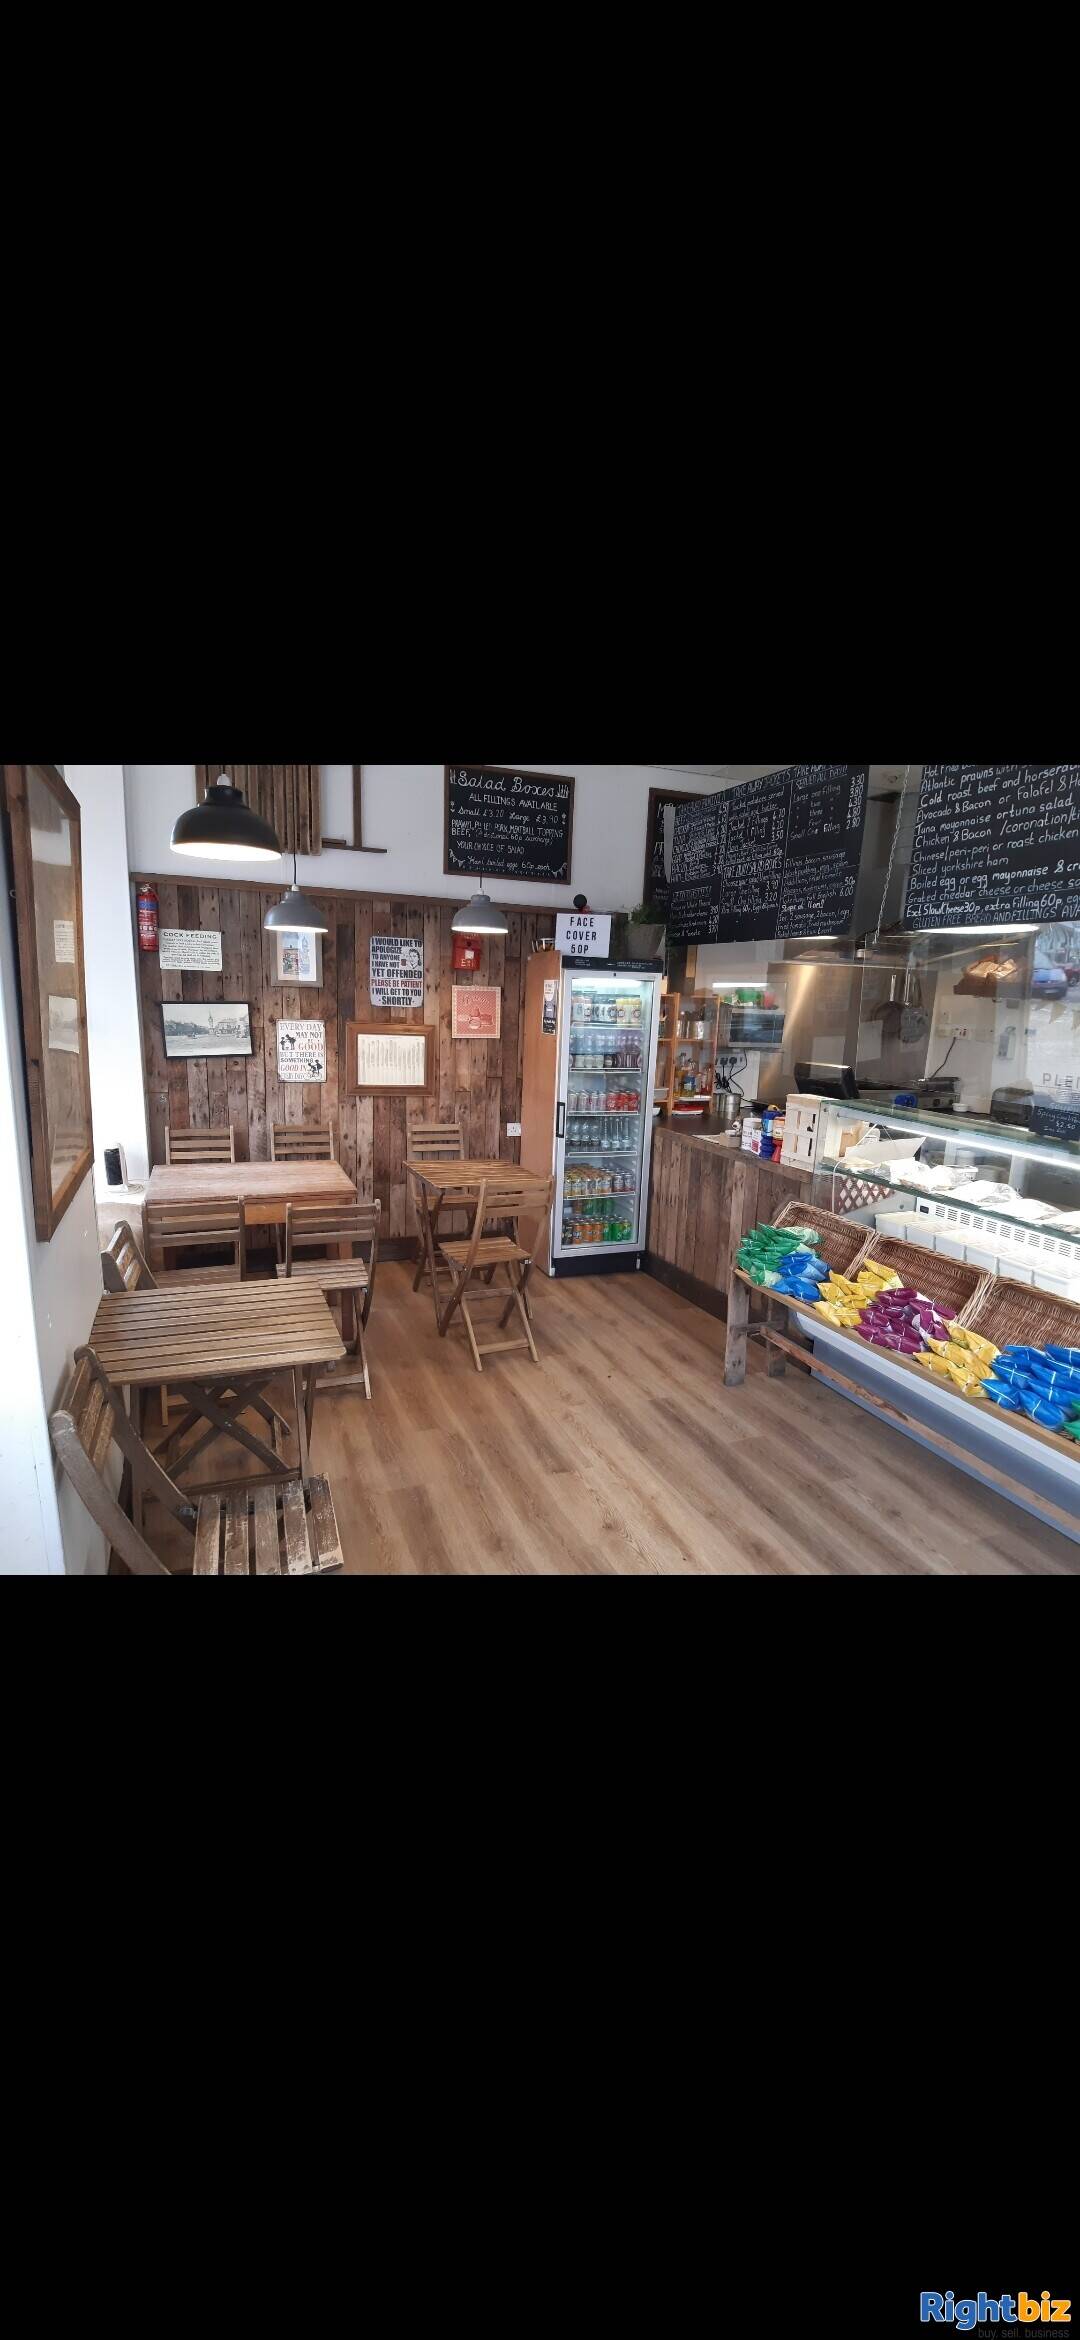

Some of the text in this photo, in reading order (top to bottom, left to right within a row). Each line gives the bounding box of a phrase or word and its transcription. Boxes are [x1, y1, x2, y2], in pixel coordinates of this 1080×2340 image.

[458, 770, 555, 797] Salad Boxes
[921, 775, 955, 791] Atlantic
[960, 768, 994, 789] prawns
[921, 790, 942, 807] Cold
[948, 783, 972, 801] roast
[978, 777, 1000, 794] beef
[1002, 770, 1021, 789] and
[469, 793, 558, 812] ALL FILLINGS AVAILABLE
[917, 805, 952, 821] Avocado
[954, 801, 962, 813] &
[962, 800, 991, 812] Bacon
[998, 795, 1011, 804] or
[1017, 779, 1054, 800] Falafel
[1057, 775, 1067, 791] &
[458, 806, 480, 817] Small
[915, 821, 936, 836] Tuna
[940, 814, 991, 833] mayonnaise
[1040, 793, 1073, 810] salad
[915, 833, 950, 847] Chicken
[953, 830, 960, 842] &
[961, 829, 992, 841] Bacon
[993, 841, 1004, 850] or
[1007, 833, 1034, 848] roast
[1038, 826, 1079, 843] chicken
[456, 840, 473, 850] YOUR
[912, 854, 1009, 878] Sliced yorkshire ham
[910, 876, 937, 891] Boiled
[940, 878, 956, 890] egg
[971, 874, 988, 889] egg
[992, 866, 1049, 884] mayonnaise
[1054, 859, 1065, 873] &
[939, 885, 975, 900] cheddar
[978, 882, 1010, 897] cheese
[1013, 883, 1024, 894] or
[1027, 878, 1063, 892] cheese
[985, 898, 1011, 911] extra
[570, 916, 595, 927] FACE
[912, 916, 940, 929] GLUTEN
[942, 914, 961, 926] FREE
[965, 912, 991, 924] BREAD
[993, 910, 1010, 922] AND
[1011, 906, 1057, 922] FILLINGS
[566, 930, 597, 942] COVER
[375, 938, 399, 946] WOULD
[400, 939, 414, 948] LIKE
[414, 940, 423, 948] TO
[570, 944, 590, 954] 50P
[371, 946, 402, 954] APOLOGIZE
[372, 968, 422, 979] YET OFFENDED
[371, 979, 391, 987] PLEASE
[400, 980, 422, 988] PATIENT
[390, 988, 401, 996] GET
[410, 989, 422, 997] YOU
[280, 1022, 305, 1031] EVERY
[299, 1042, 324, 1051] GOOD
